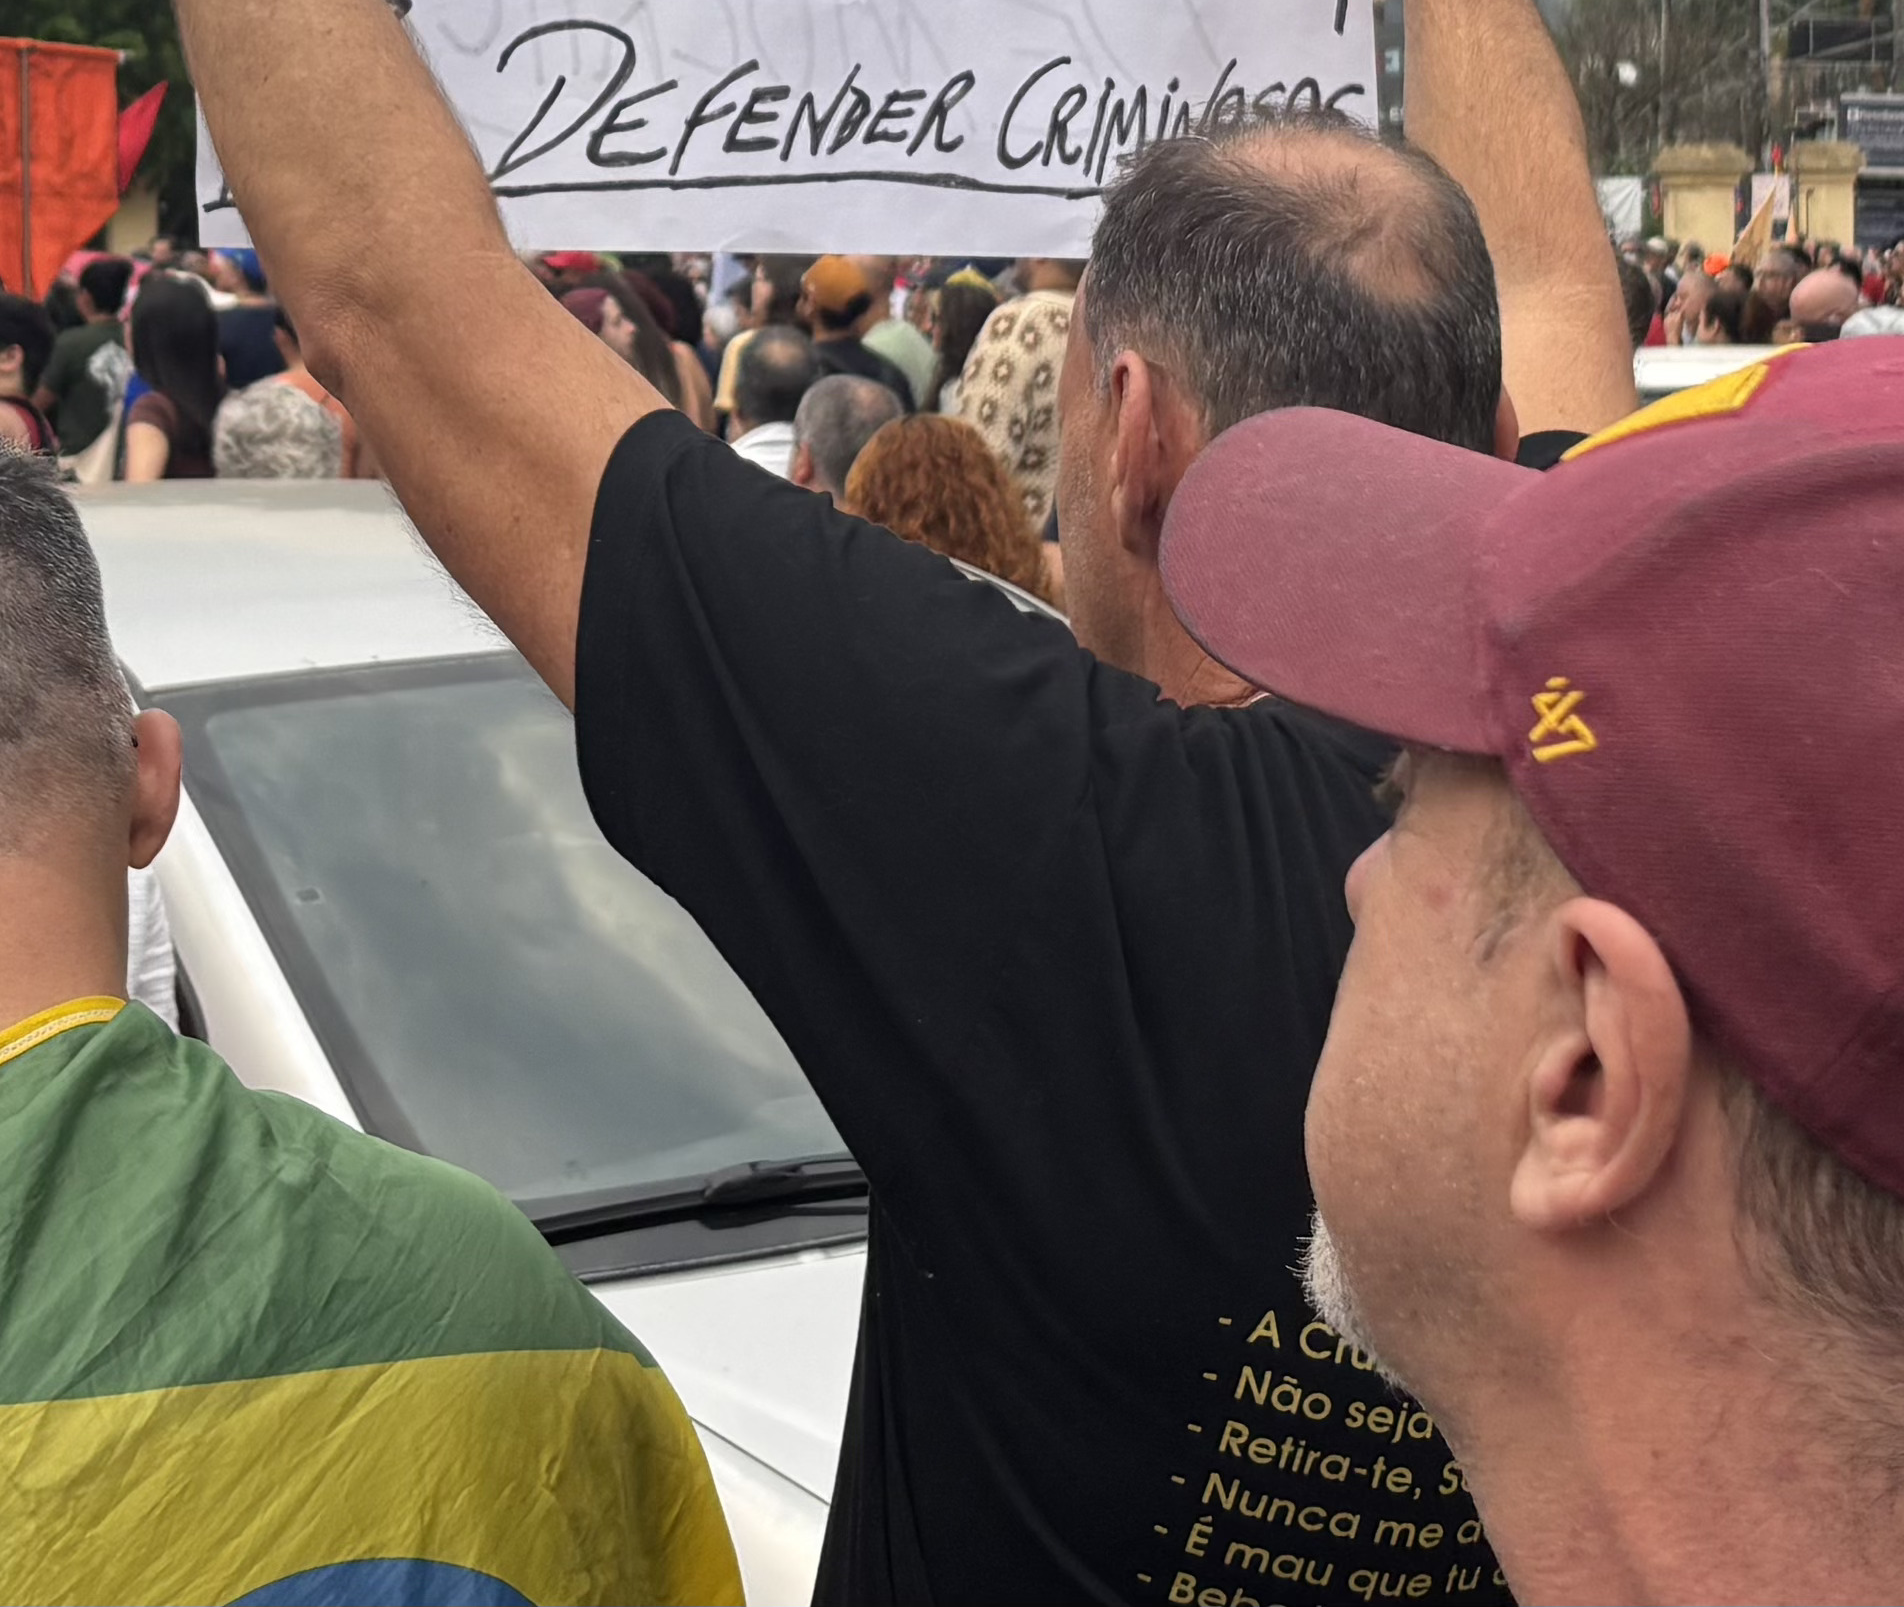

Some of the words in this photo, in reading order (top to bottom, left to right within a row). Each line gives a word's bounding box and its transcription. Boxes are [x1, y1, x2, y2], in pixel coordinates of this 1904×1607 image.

[486, 19, 976, 186] DEFENDER
[1247, 1309, 1281, 1349] A
[1234, 1364, 1333, 1421] Não
[1344, 1399, 1435, 1444] seja
[1218, 1419, 1422, 1500] Retira-te,
[1201, 1472, 1361, 1539] Nunca
[1374, 1519, 1444, 1550] me
[1185, 1515, 1214, 1557] É
[1224, 1540, 1335, 1588] mau
[1348, 1566, 1433, 1602] que
[1445, 1565, 1482, 1595] tu
